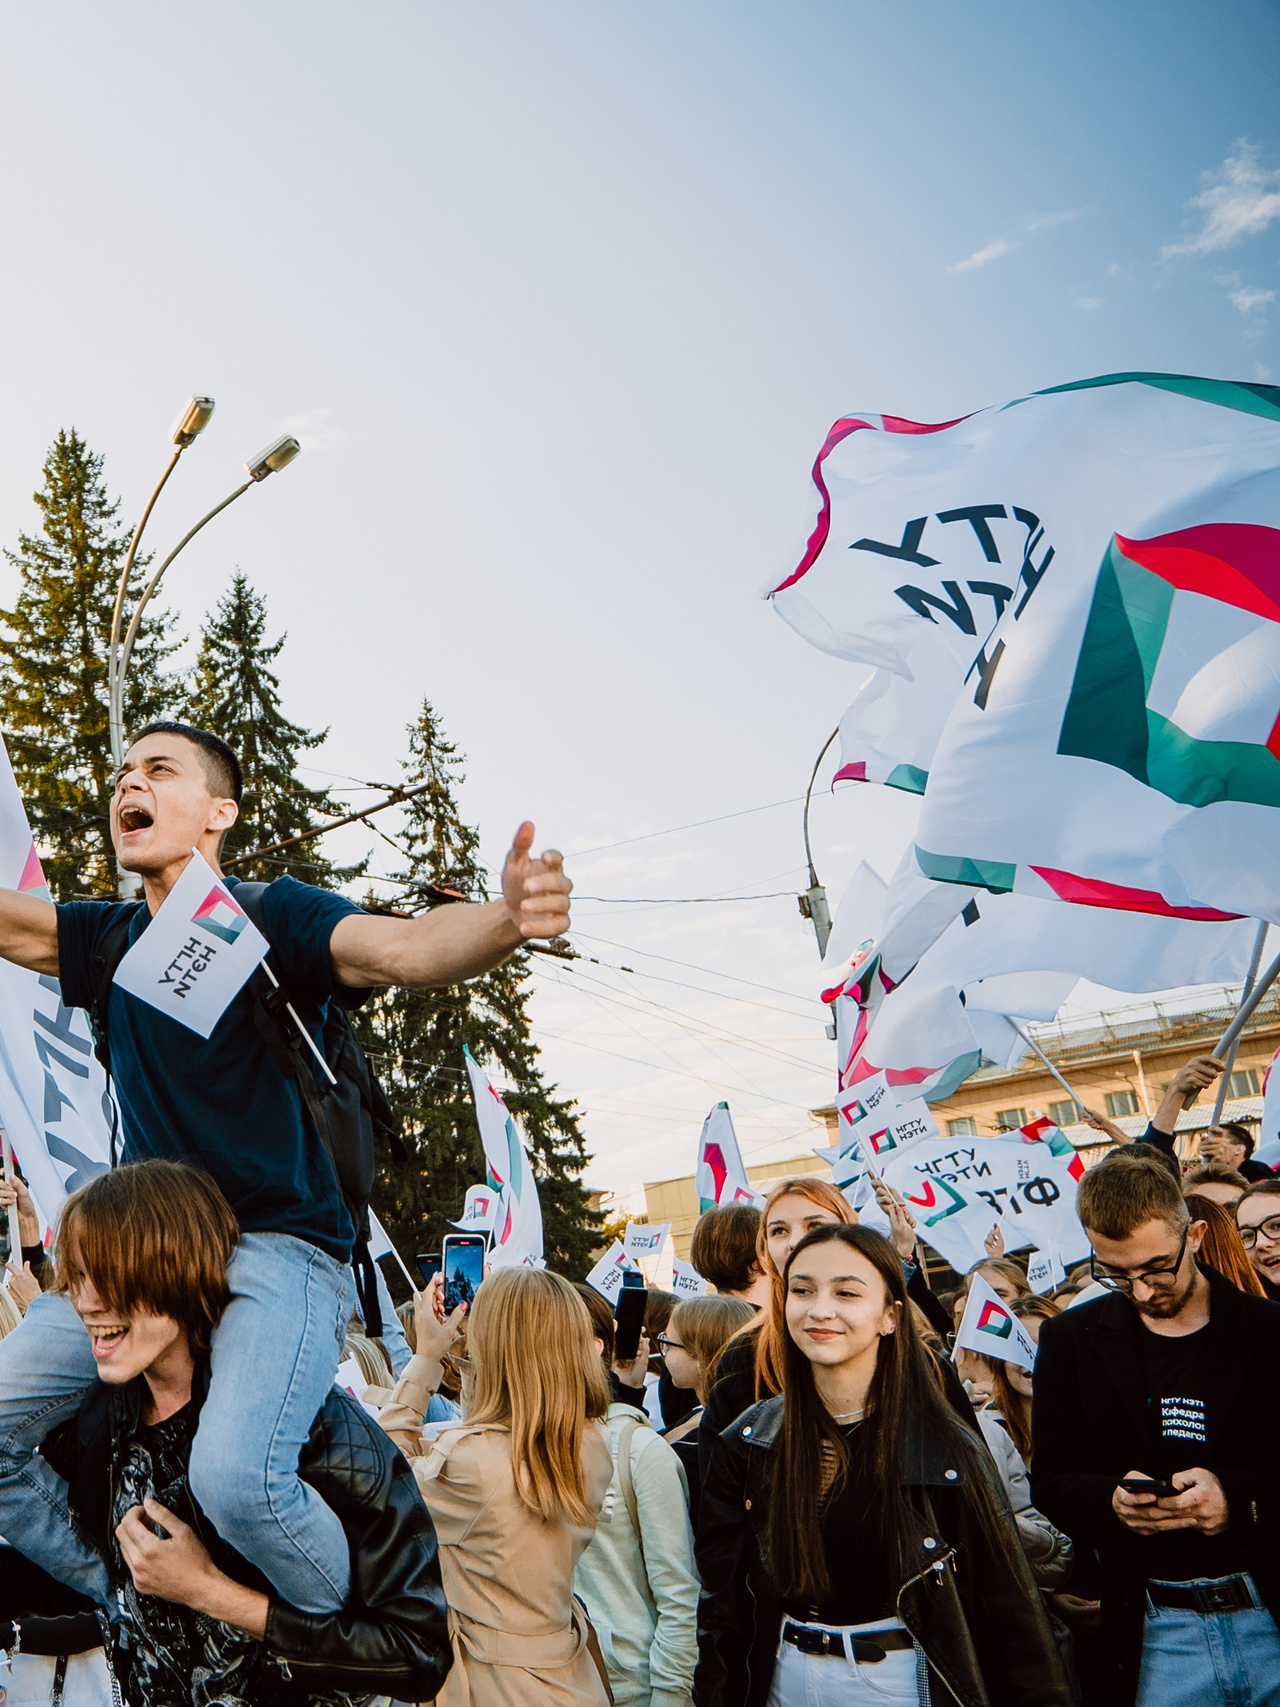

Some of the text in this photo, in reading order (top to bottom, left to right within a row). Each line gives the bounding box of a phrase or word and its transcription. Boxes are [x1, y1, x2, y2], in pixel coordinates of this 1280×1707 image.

[895, 1118, 922, 1134] НГТУ
[899, 1125, 927, 1141] НЭТИ
[940, 1161, 992, 1183] ЭТИ
